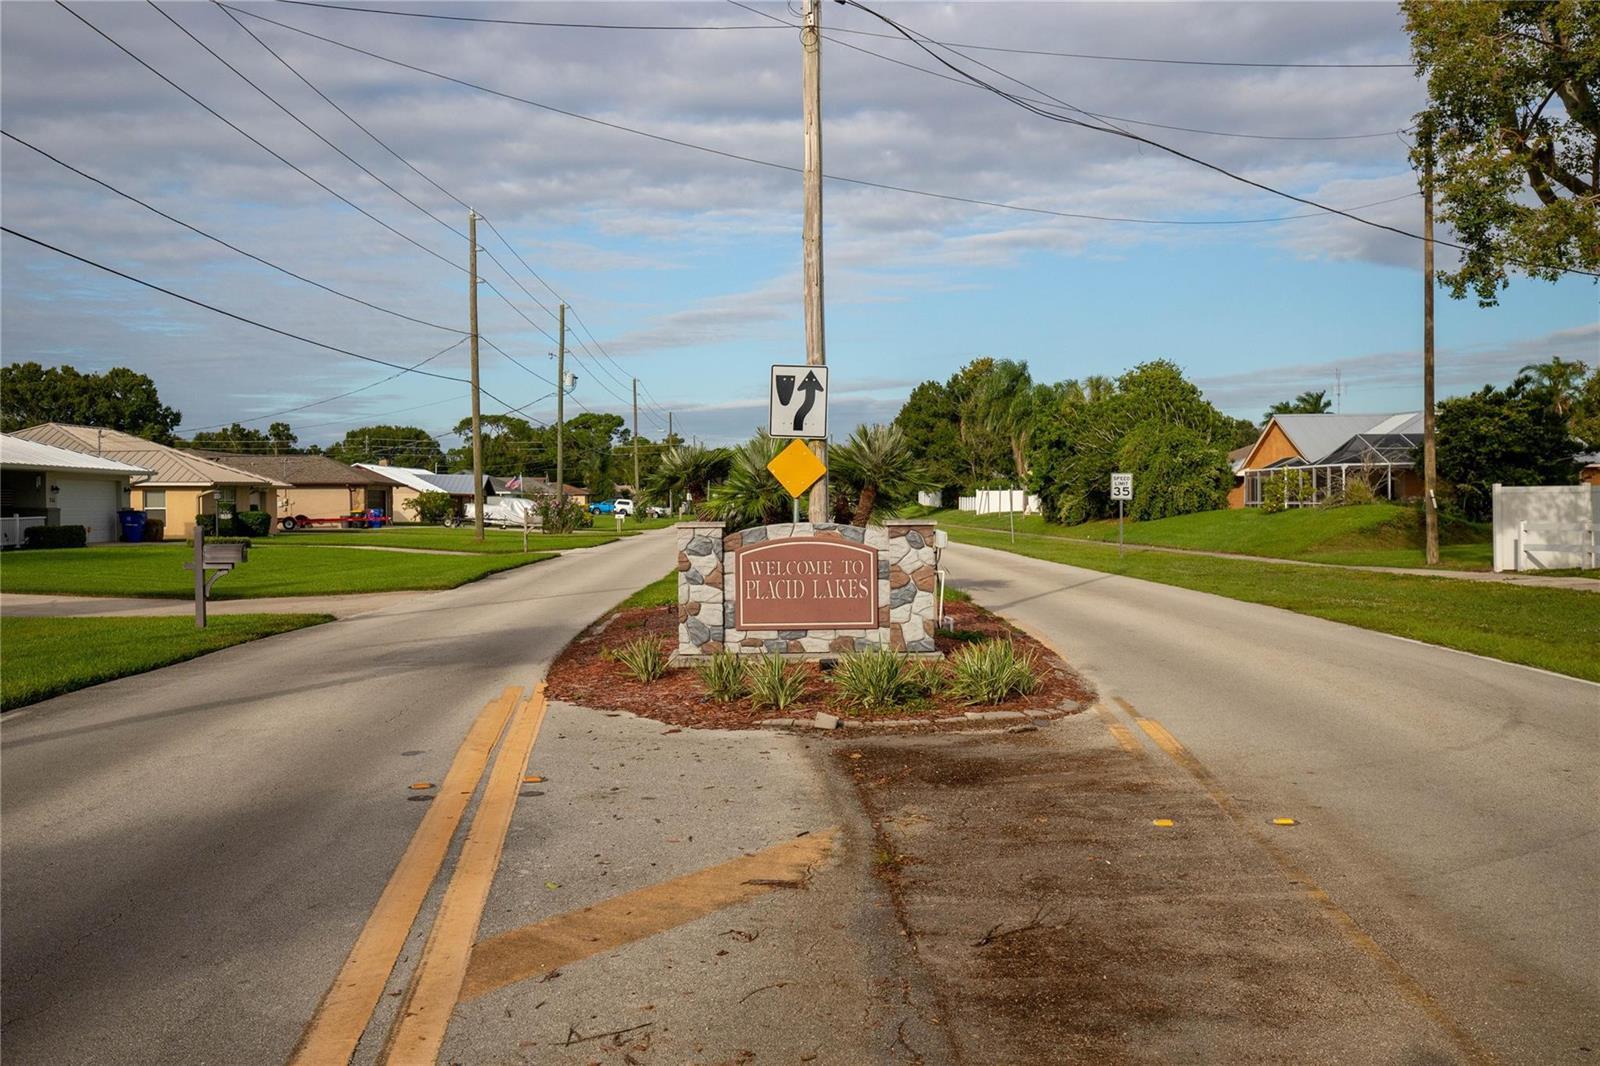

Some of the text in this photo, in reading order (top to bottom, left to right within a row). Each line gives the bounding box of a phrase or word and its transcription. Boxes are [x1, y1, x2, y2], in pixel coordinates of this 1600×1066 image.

[1113, 486, 1130, 496] 35
[749, 559, 865, 575] WELCOME TO
[744, 578, 869, 600] PLACID LAKES
